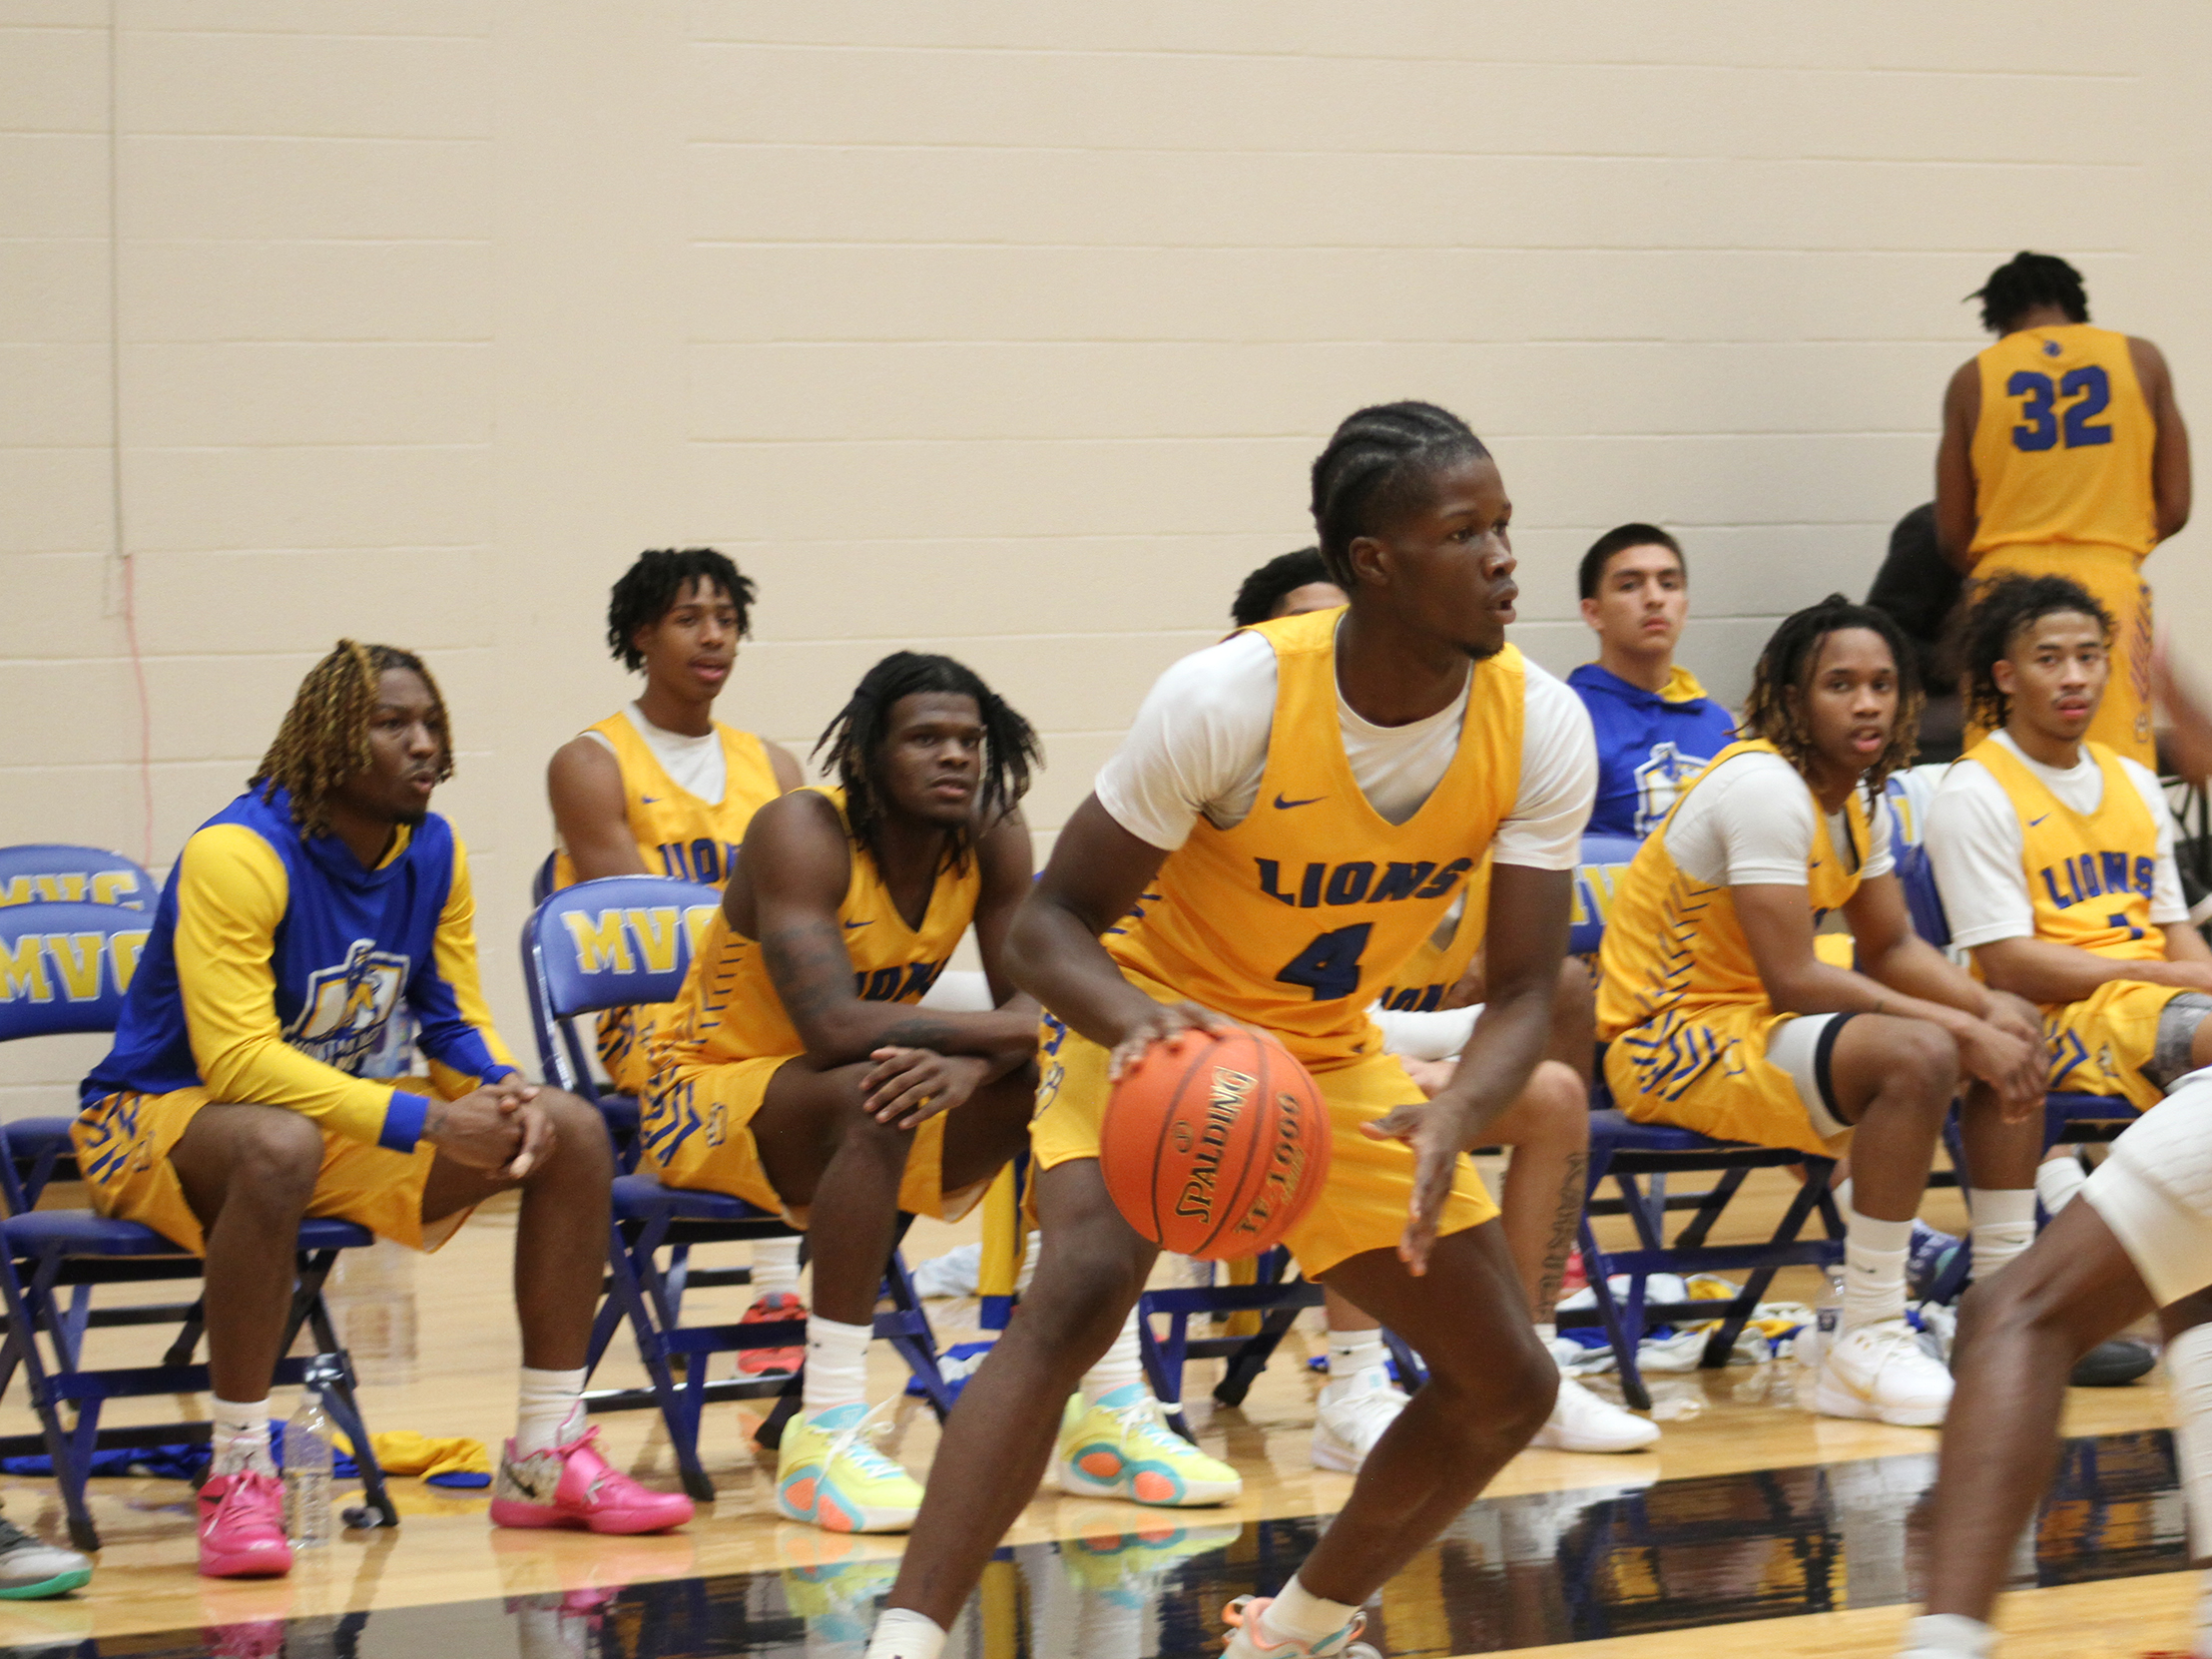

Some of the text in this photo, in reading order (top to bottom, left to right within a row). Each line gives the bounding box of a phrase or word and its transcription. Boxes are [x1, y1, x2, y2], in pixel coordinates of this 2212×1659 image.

[2006, 364, 2113, 452] 32
[1254, 856, 1473, 908] LIONS
[2040, 850, 2155, 910] LIONS
[1275, 921, 1377, 1002] 4
[1175, 1065, 1260, 1225] SPALDING
